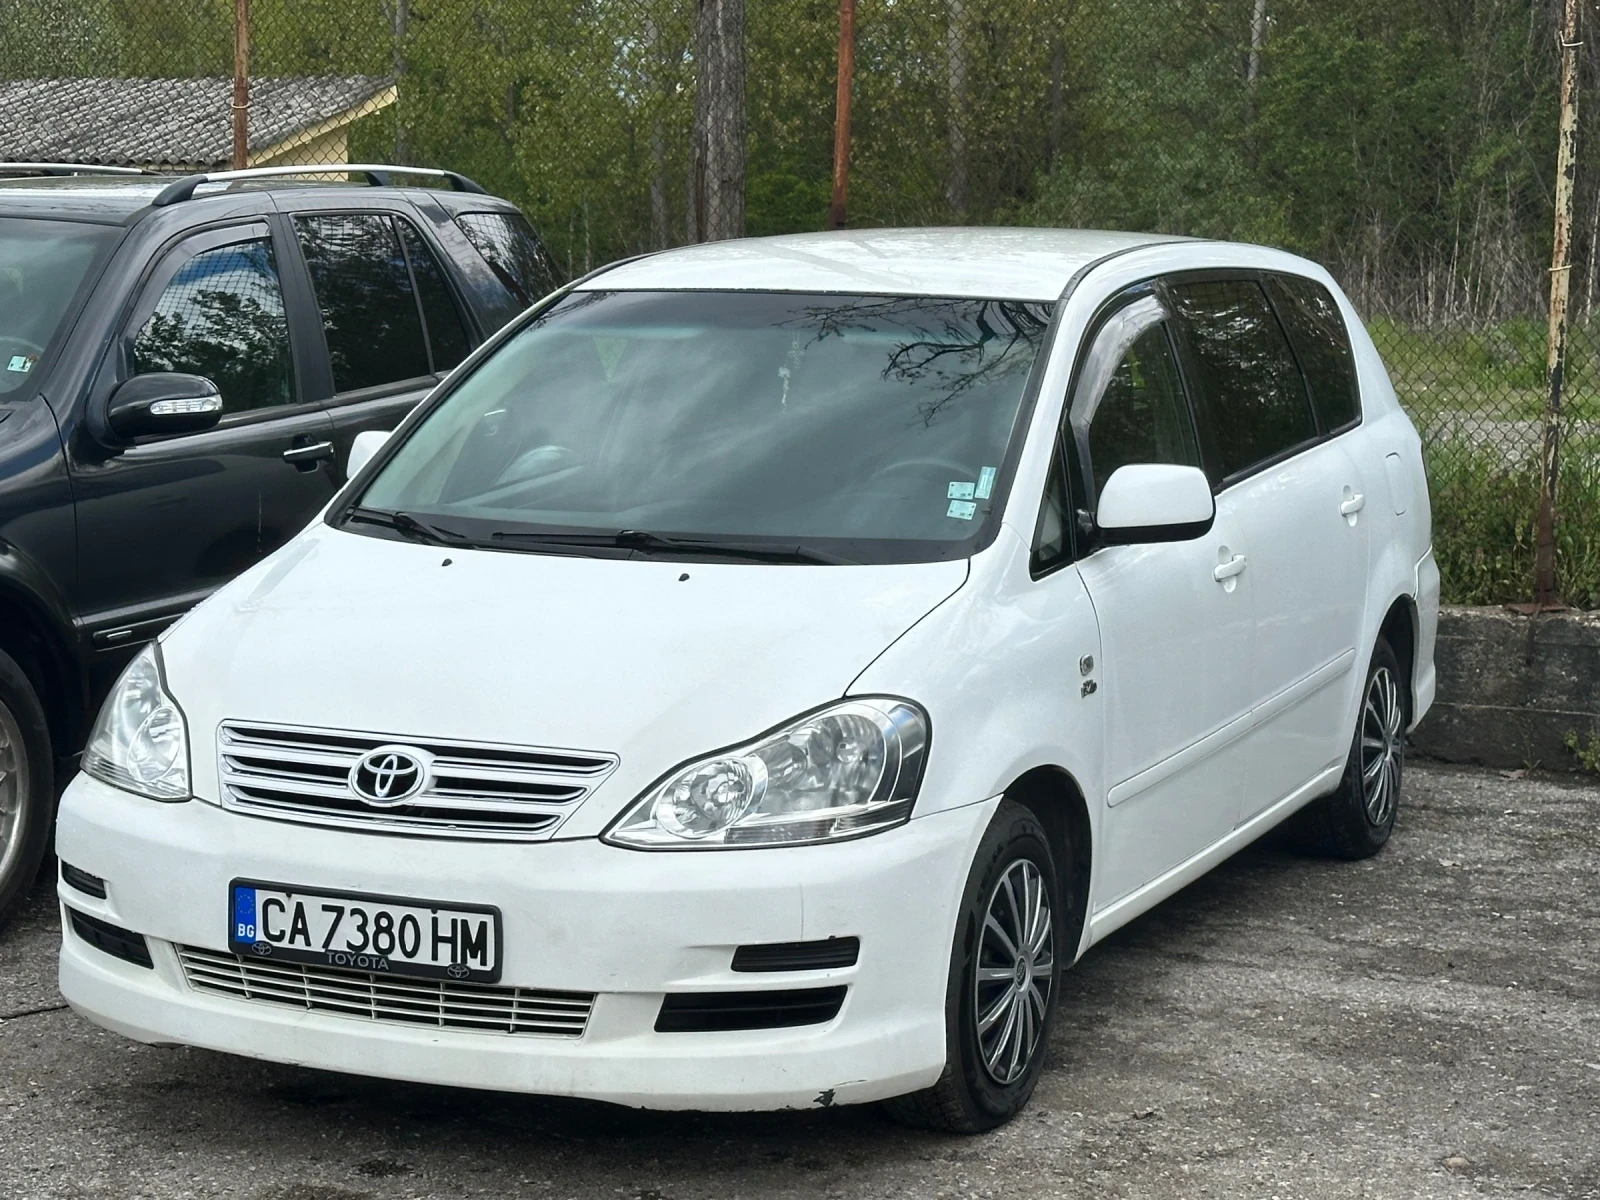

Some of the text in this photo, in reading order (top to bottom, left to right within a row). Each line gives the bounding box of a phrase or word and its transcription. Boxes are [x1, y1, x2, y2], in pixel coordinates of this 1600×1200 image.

[237, 923, 255, 939] BG
[262, 898, 488, 967] CA 7380 HM
[326, 952, 390, 971] TOYOTA
